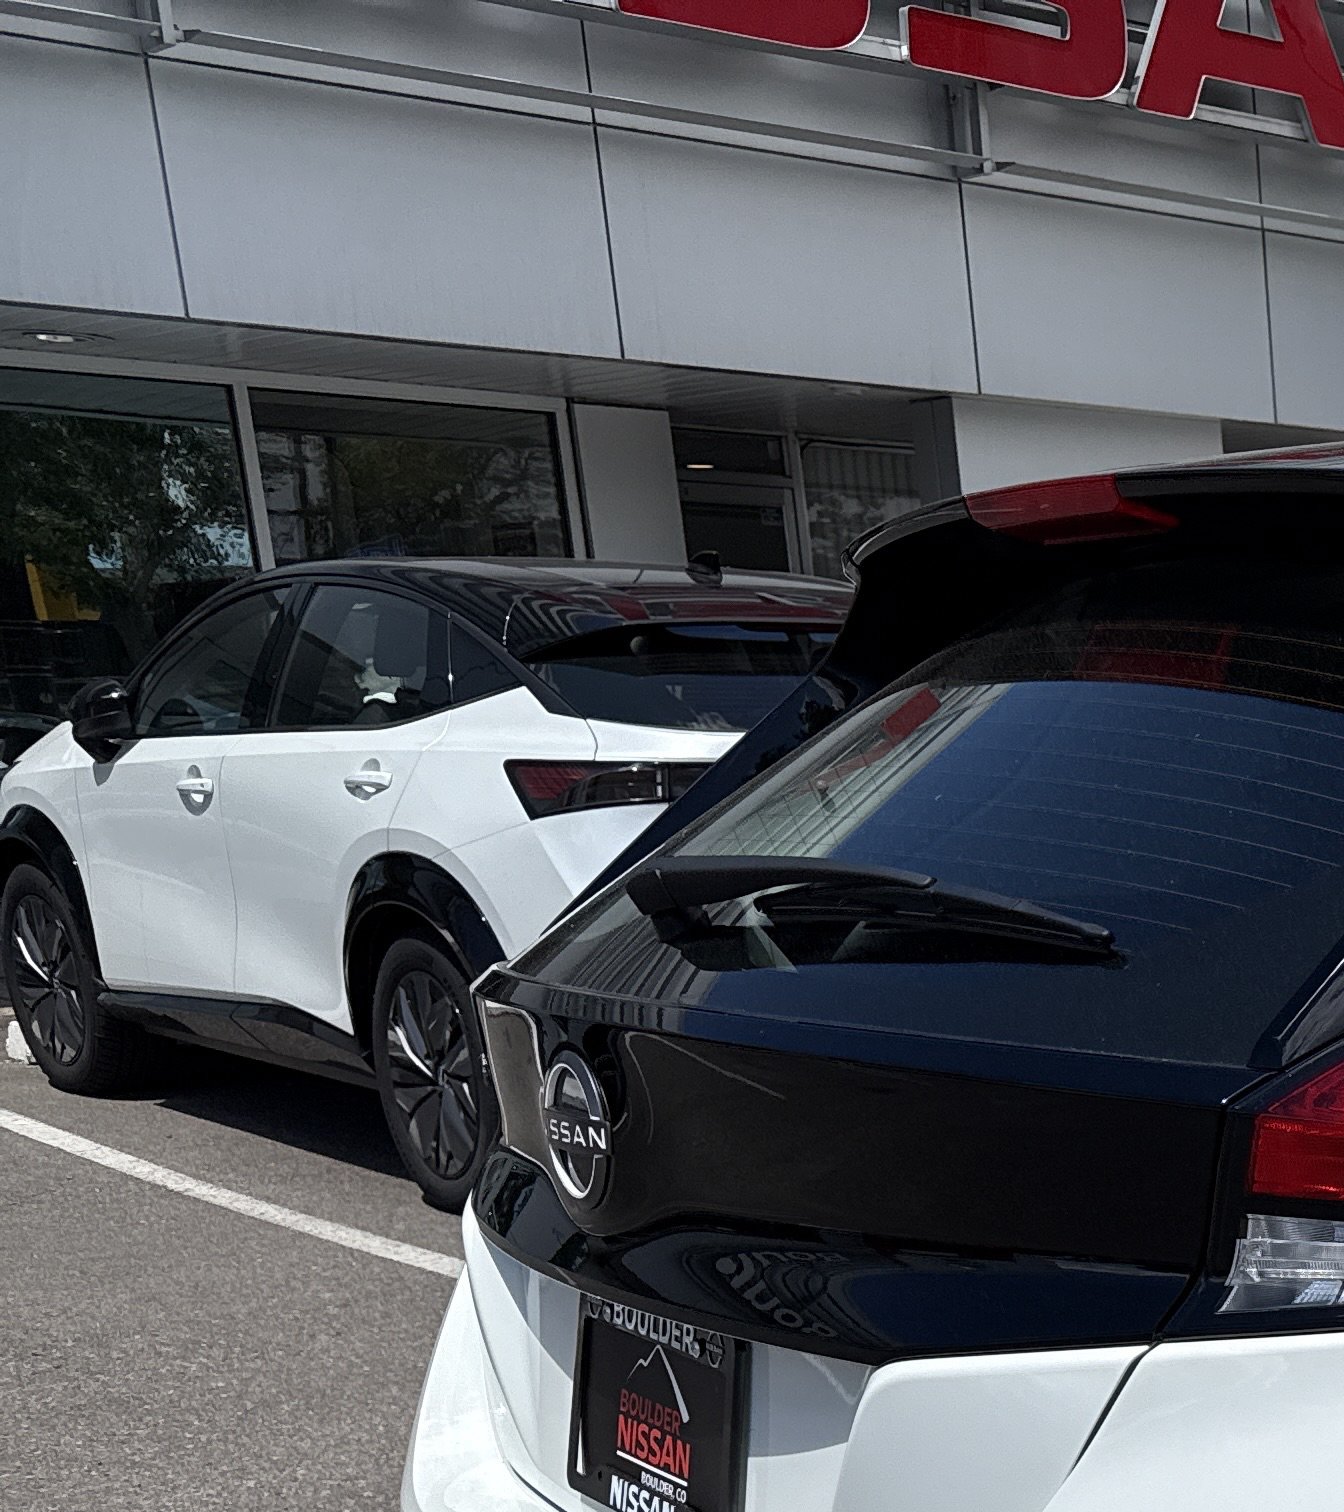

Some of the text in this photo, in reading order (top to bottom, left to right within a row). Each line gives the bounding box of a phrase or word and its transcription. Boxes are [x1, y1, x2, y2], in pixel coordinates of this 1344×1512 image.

[544, 1118, 607, 1150] SSAN
[613, 1303, 698, 1357] BOULDER
[619, 1388, 681, 1436] BOULDER
[617, 1414, 691, 1479] NISSAN
